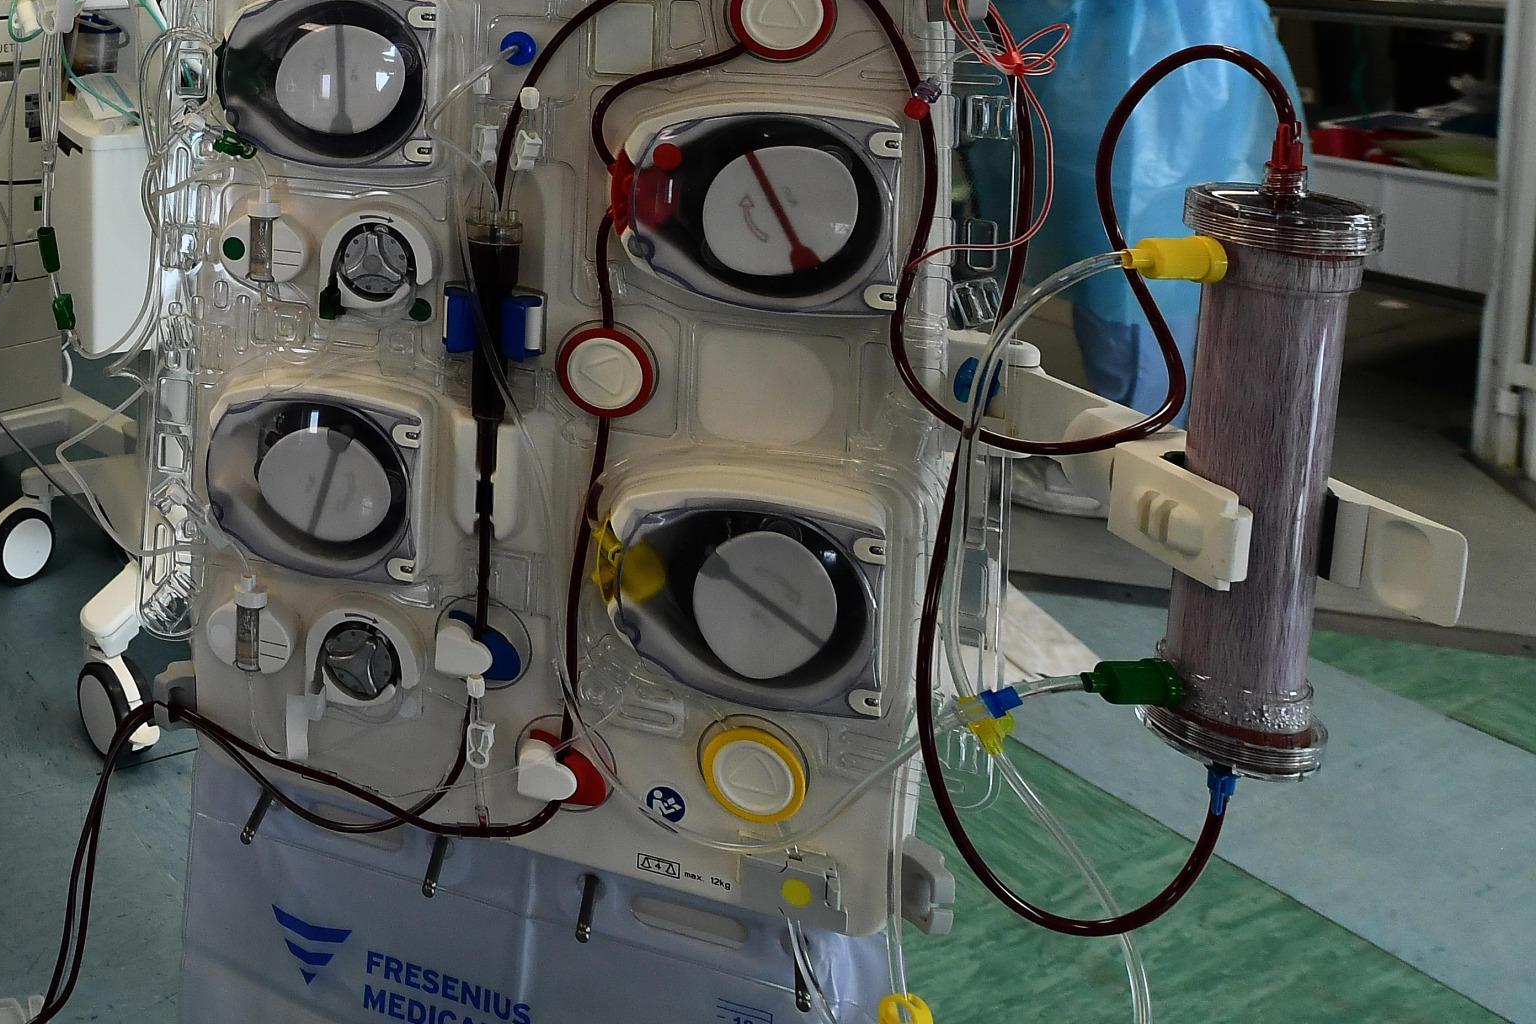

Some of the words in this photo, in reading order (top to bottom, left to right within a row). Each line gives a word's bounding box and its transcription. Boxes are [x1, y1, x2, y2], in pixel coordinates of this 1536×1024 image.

[684, 871, 705, 882] max.
[710, 877, 731, 891] 12kg
[366, 950, 531, 1024] FRESENIUS
